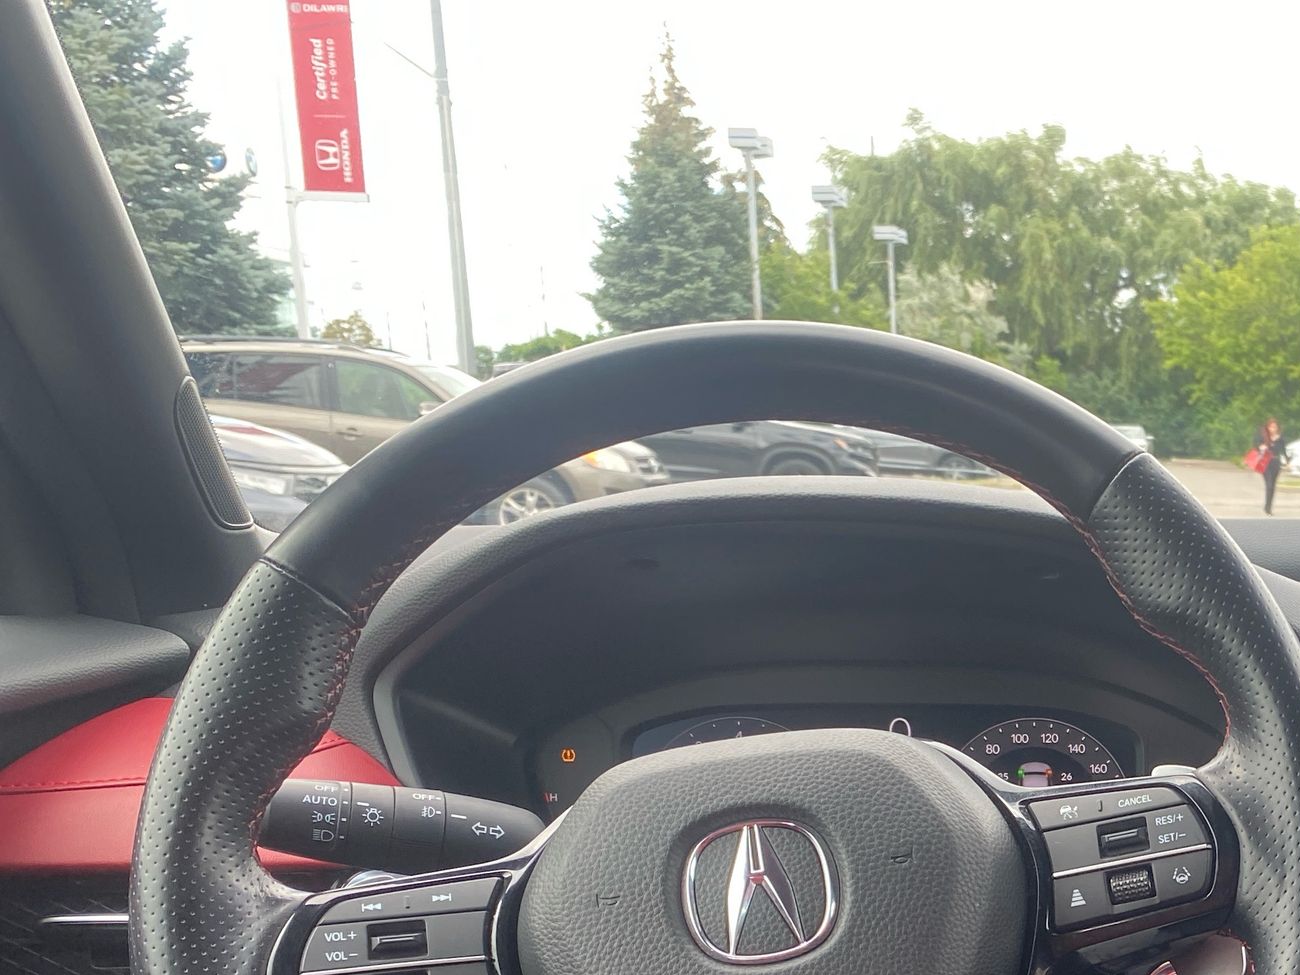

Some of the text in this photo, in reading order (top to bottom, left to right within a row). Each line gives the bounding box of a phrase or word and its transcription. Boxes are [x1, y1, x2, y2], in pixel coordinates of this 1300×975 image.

[302, 3, 349, 13] DILAWRI
[308, 37, 328, 100] Certified
[326, 38, 340, 100] PRE-OWNED
[340, 128, 354, 183] HONDA
[1011, 733, 1029, 744] 100
[1040, 733, 1059, 744] 120
[985, 744, 1000, 755] 80
[1068, 743, 1086, 754] 140
[1089, 763, 1108, 774] 160
[1060, 773, 1073, 781] 26
[314, 784, 339, 792] OFF
[302, 794, 338, 807] AUTO
[412, 793, 435, 801] OFF
[1118, 794, 1153, 808] CANCEL
[1155, 813, 1184, 826] RES/+
